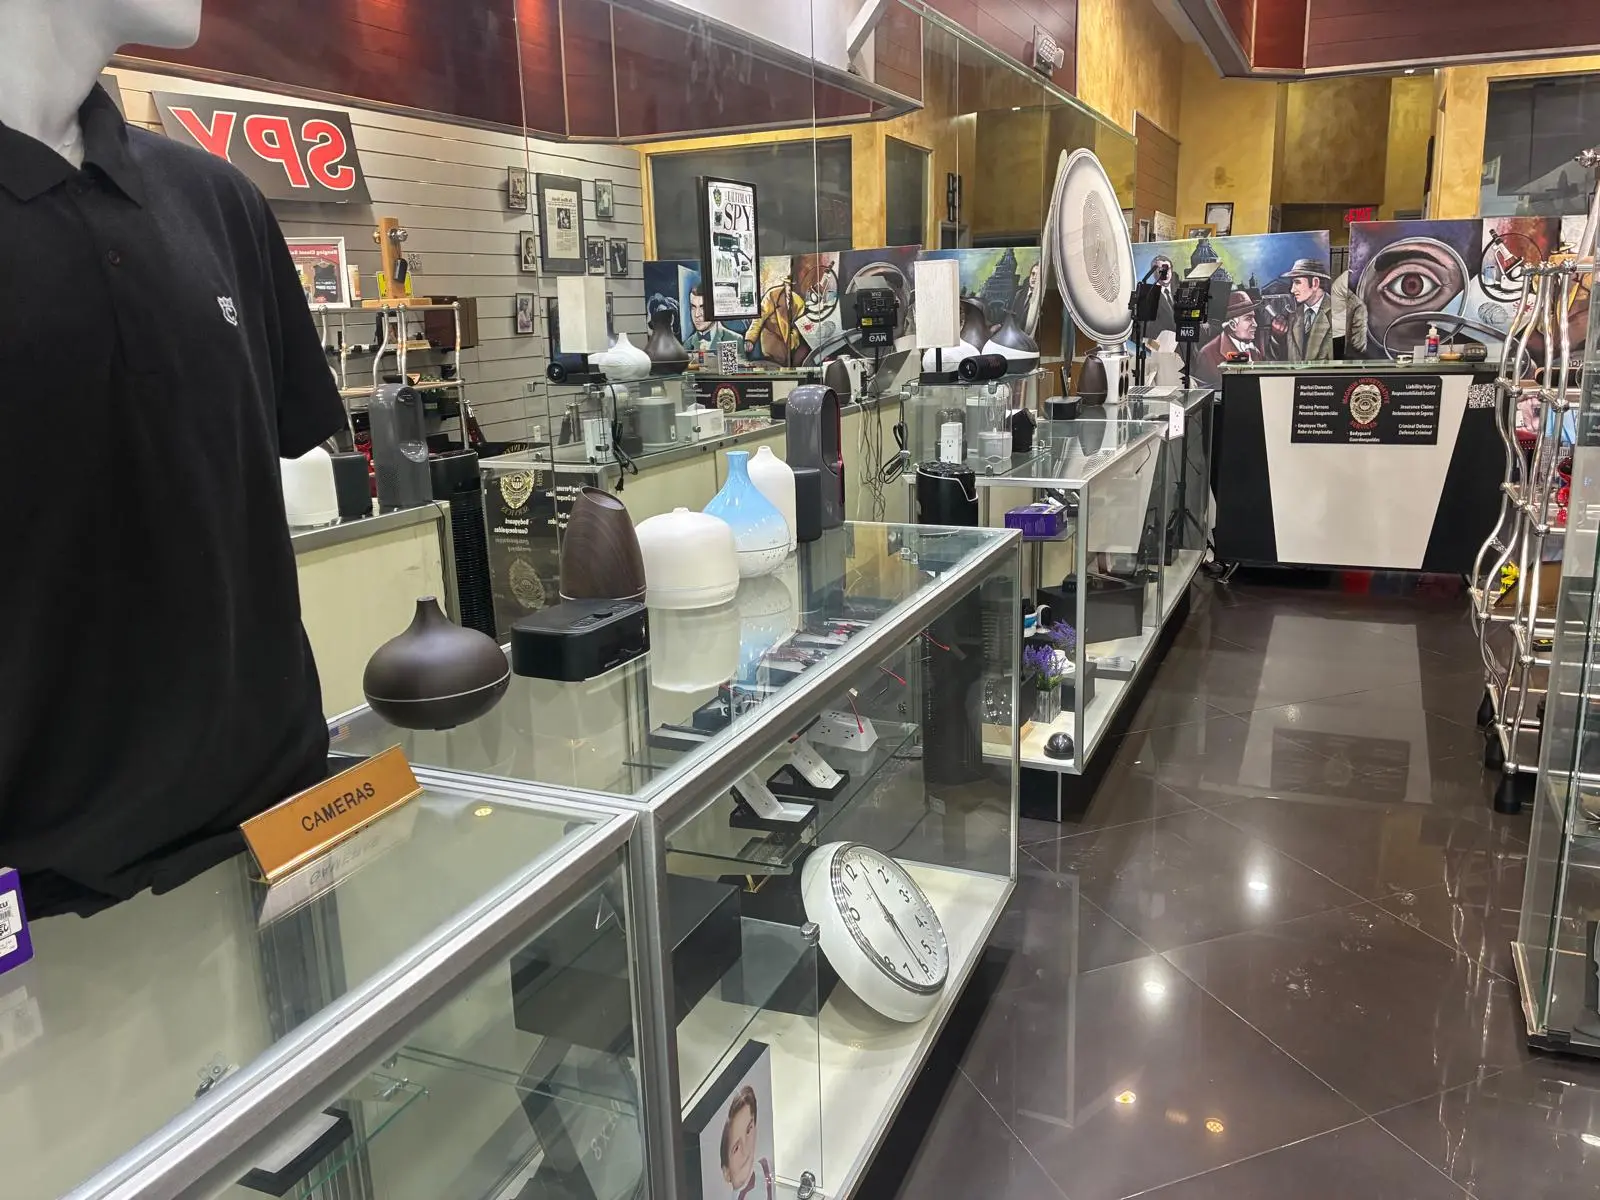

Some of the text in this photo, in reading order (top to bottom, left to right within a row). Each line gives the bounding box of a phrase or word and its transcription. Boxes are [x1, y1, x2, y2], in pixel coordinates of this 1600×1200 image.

[724, 202, 752, 231] SPY
[301, 782, 376, 832] CAMERAS
[877, 869, 889, 884] 2
[899, 889, 910, 903] 3
[914, 914, 925, 928] 4
[920, 940, 931, 955] 5
[903, 962, 914, 979] 7
